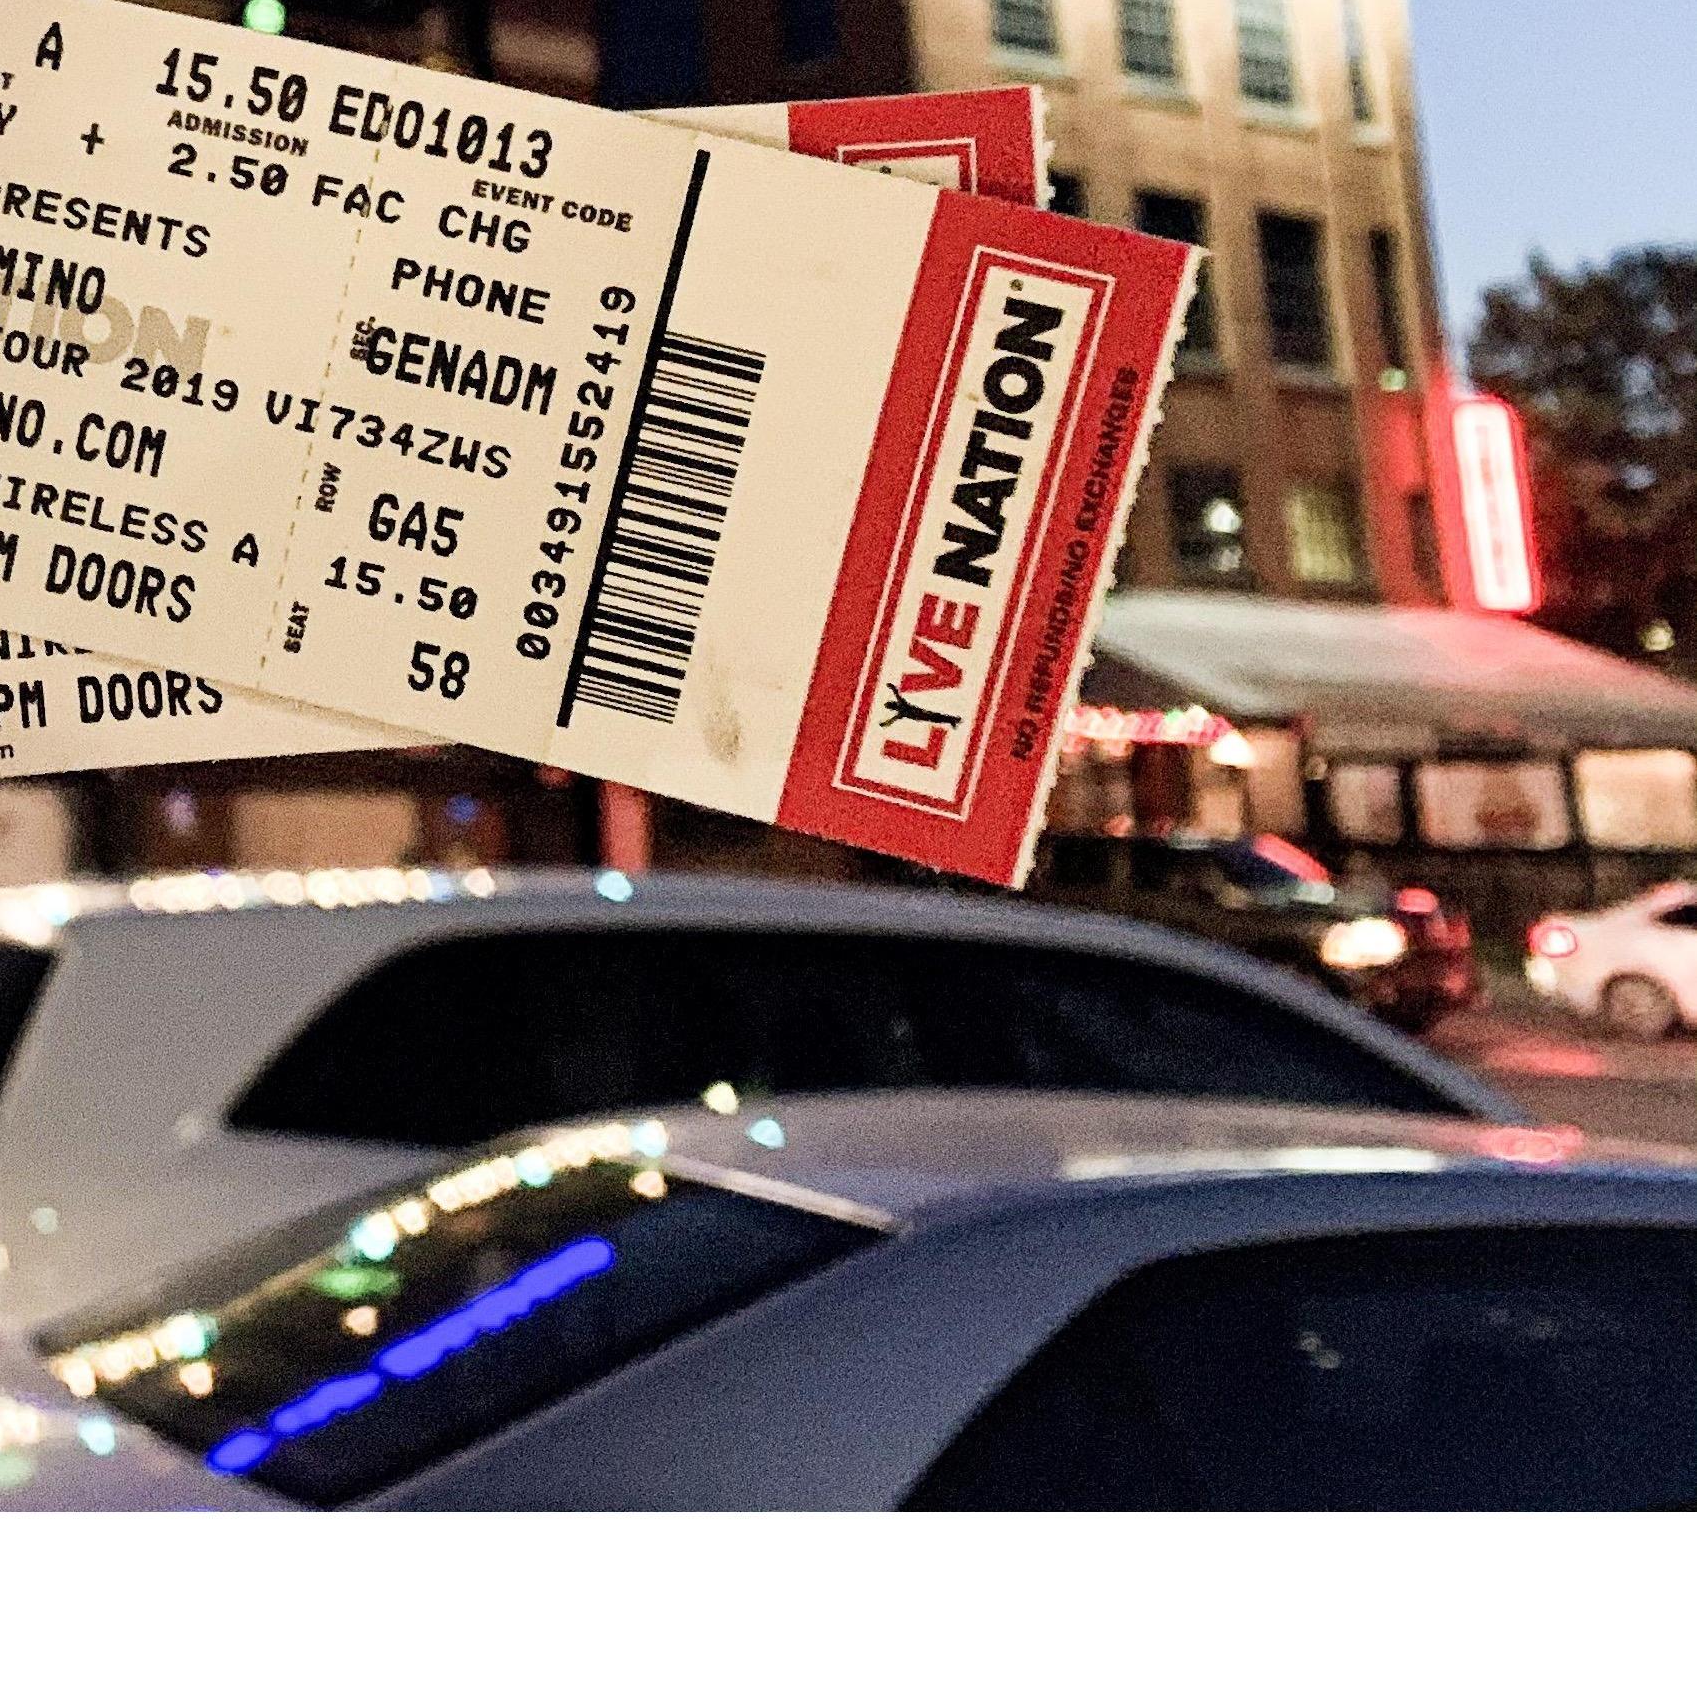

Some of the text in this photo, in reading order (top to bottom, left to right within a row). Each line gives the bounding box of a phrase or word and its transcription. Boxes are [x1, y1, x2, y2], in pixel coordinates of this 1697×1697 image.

[35, 22, 66, 71] A
[156, 47, 309, 123] 15.50
[167, 110, 309, 157] ADMISSION
[167, 143, 289, 197] 2.50
[311, 175, 405, 224] FAC
[438, 205, 533, 254] CHG
[472, 178, 634, 233] EVENT CODE
[392, 257, 551, 326] PHONE
[365, 326, 558, 416] GENADM
[120, 357, 239, 413] 2019
[266, 390, 512, 479] VI734ZWS
[315, 462, 342, 513] ROW
[515, 285, 636, 661] 003491552419
[231, 532, 260, 568] A
[368, 493, 464, 558] GA5
[879, 296, 1066, 771] LIVE NATION
[45, 544, 197, 623] DOORS
[324, 556, 479, 621] 15.50
[282, 600, 310, 654] SEAT
[77, 669, 223, 723] DOORS
[407, 640, 471, 701] 58
